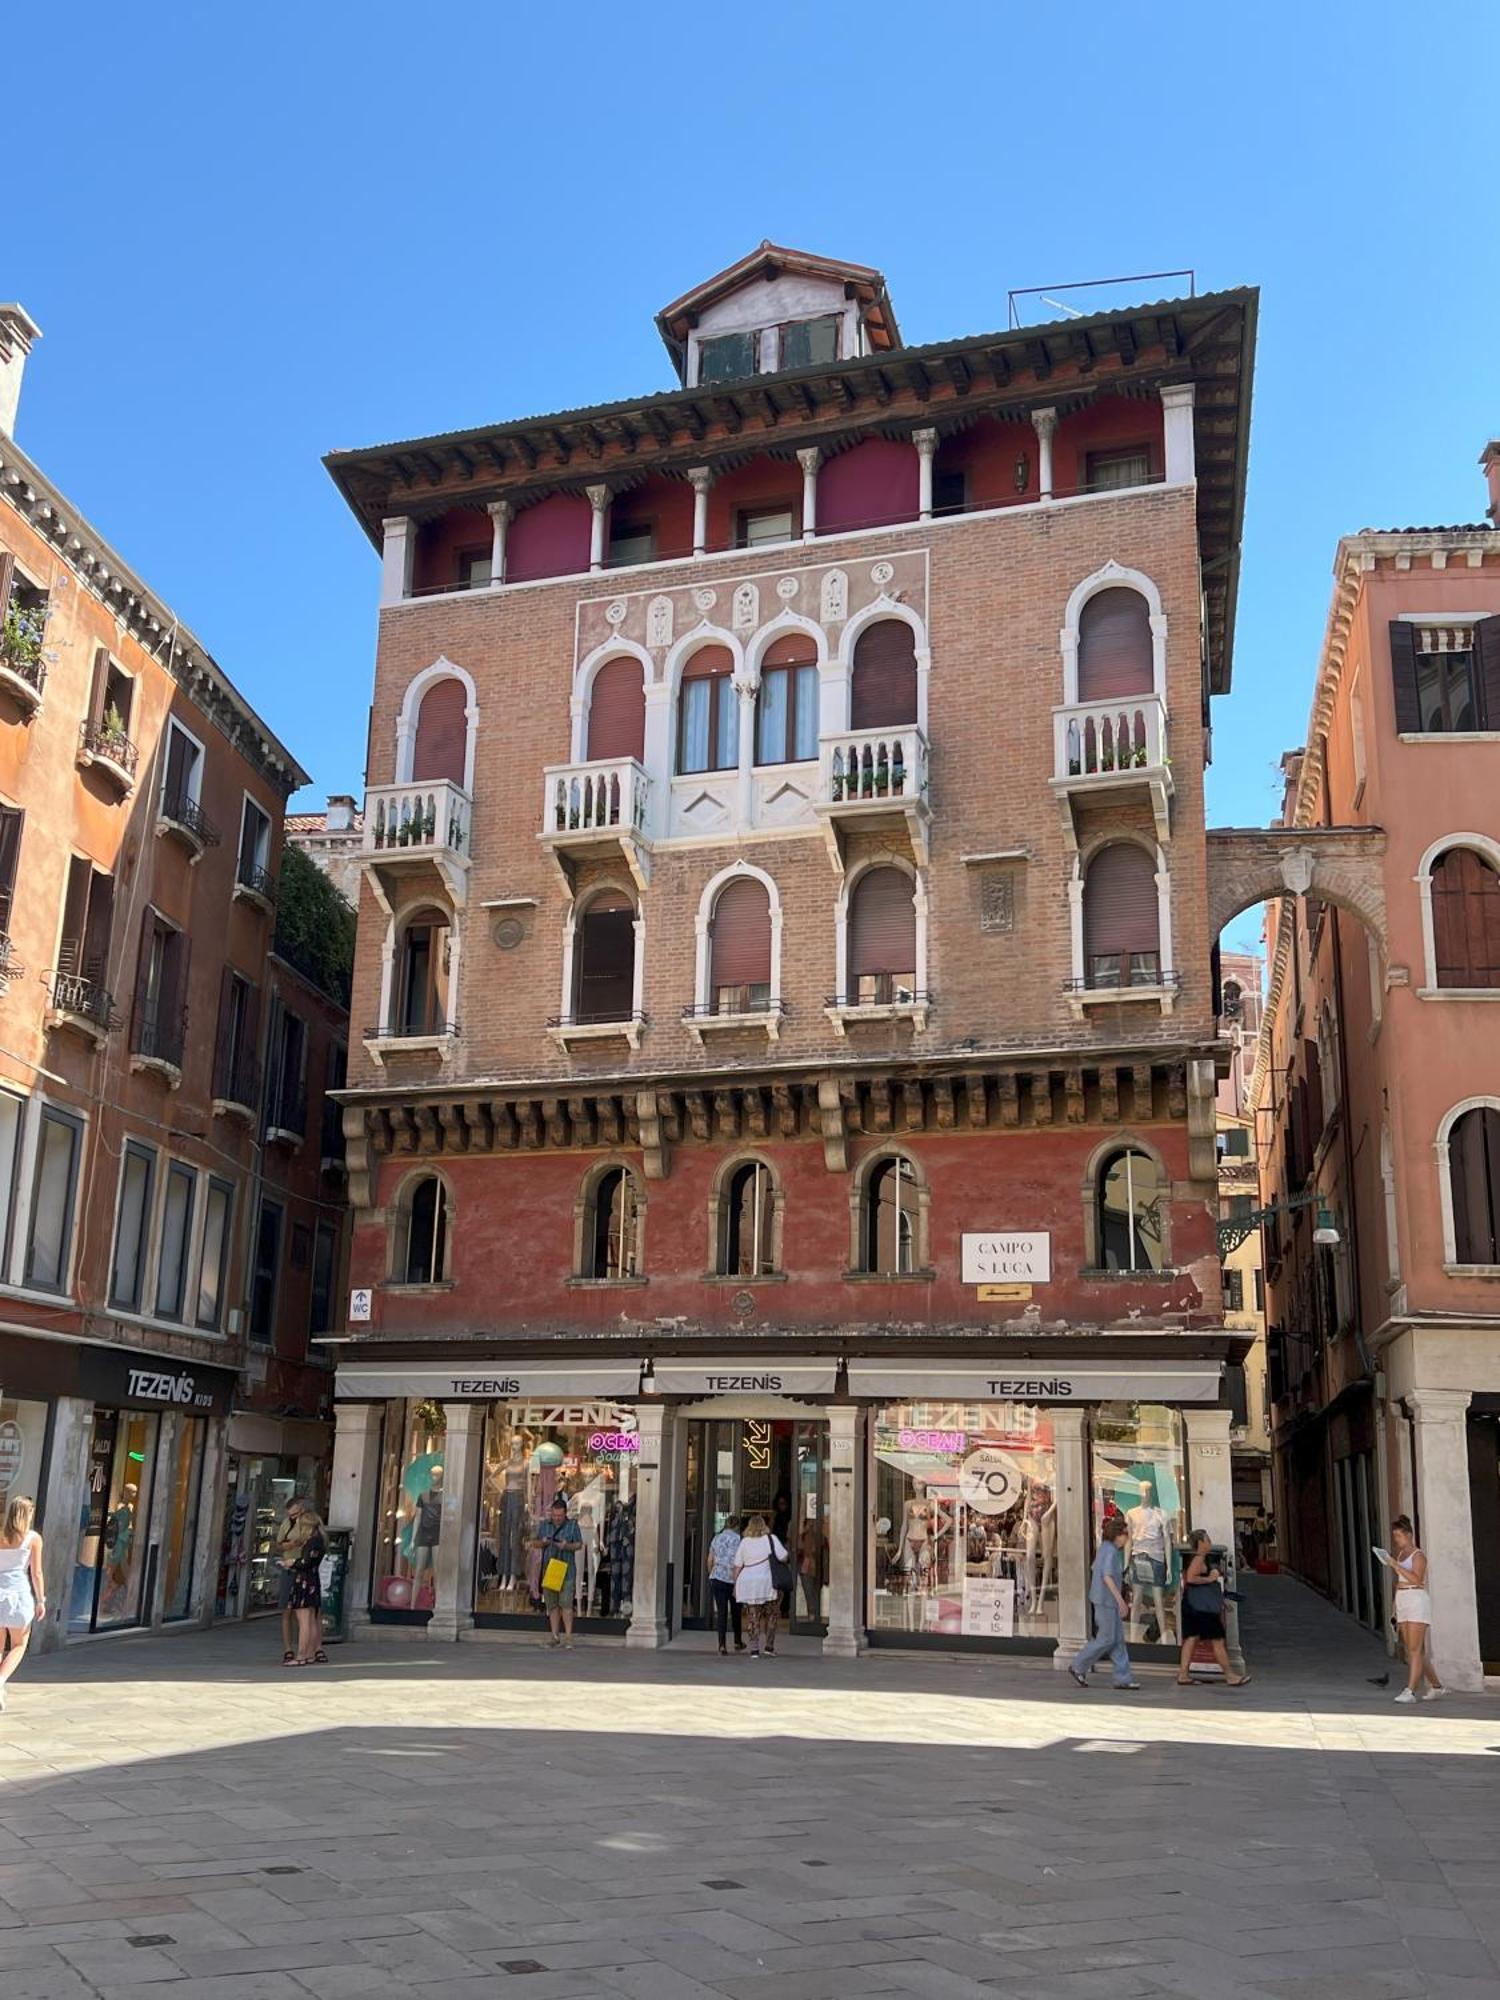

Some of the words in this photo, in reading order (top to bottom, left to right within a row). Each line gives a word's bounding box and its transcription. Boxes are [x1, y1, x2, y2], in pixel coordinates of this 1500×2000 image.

[978, 1242, 1033, 1254] CAMPO
[992, 1262, 1033, 1274] LUCA
[353, 1303, 368, 1313] WC
[193, 1393, 214, 1408] KIDS
[971, 1471, 1009, 1496] 70
